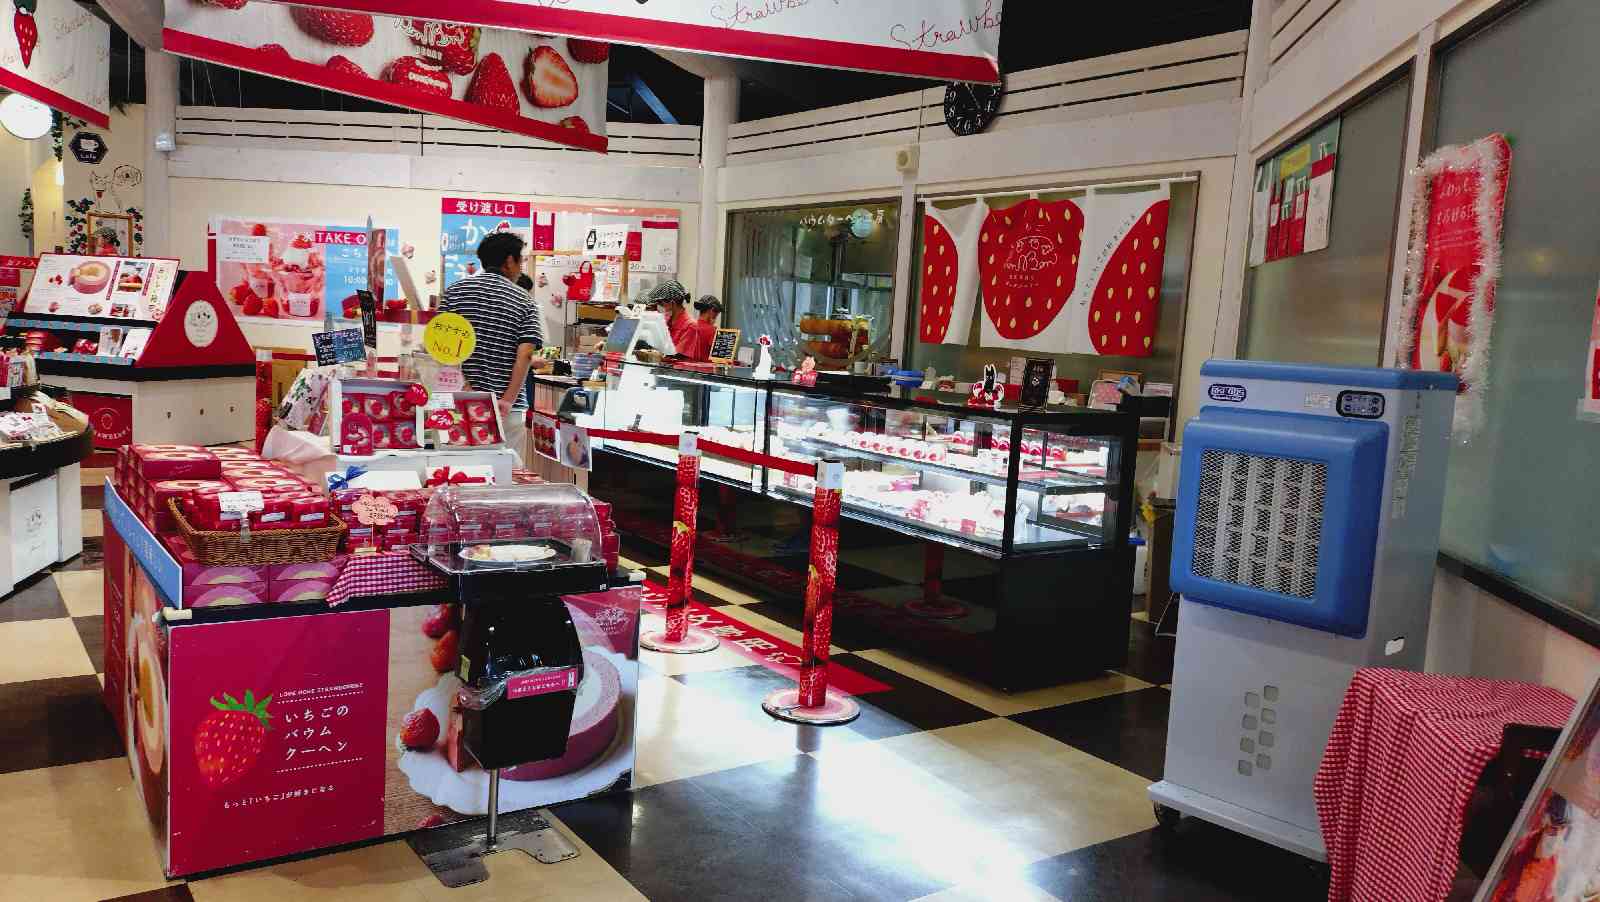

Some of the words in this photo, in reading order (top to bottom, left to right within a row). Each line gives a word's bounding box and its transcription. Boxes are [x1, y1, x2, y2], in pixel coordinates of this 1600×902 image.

[456, 200, 515, 215] 受け渡し口
[316, 231, 351, 245] TAKE
[285, 705, 349, 723] いちごの
[284, 726, 332, 740] バウム
[285, 741, 348, 761] クーヘン
